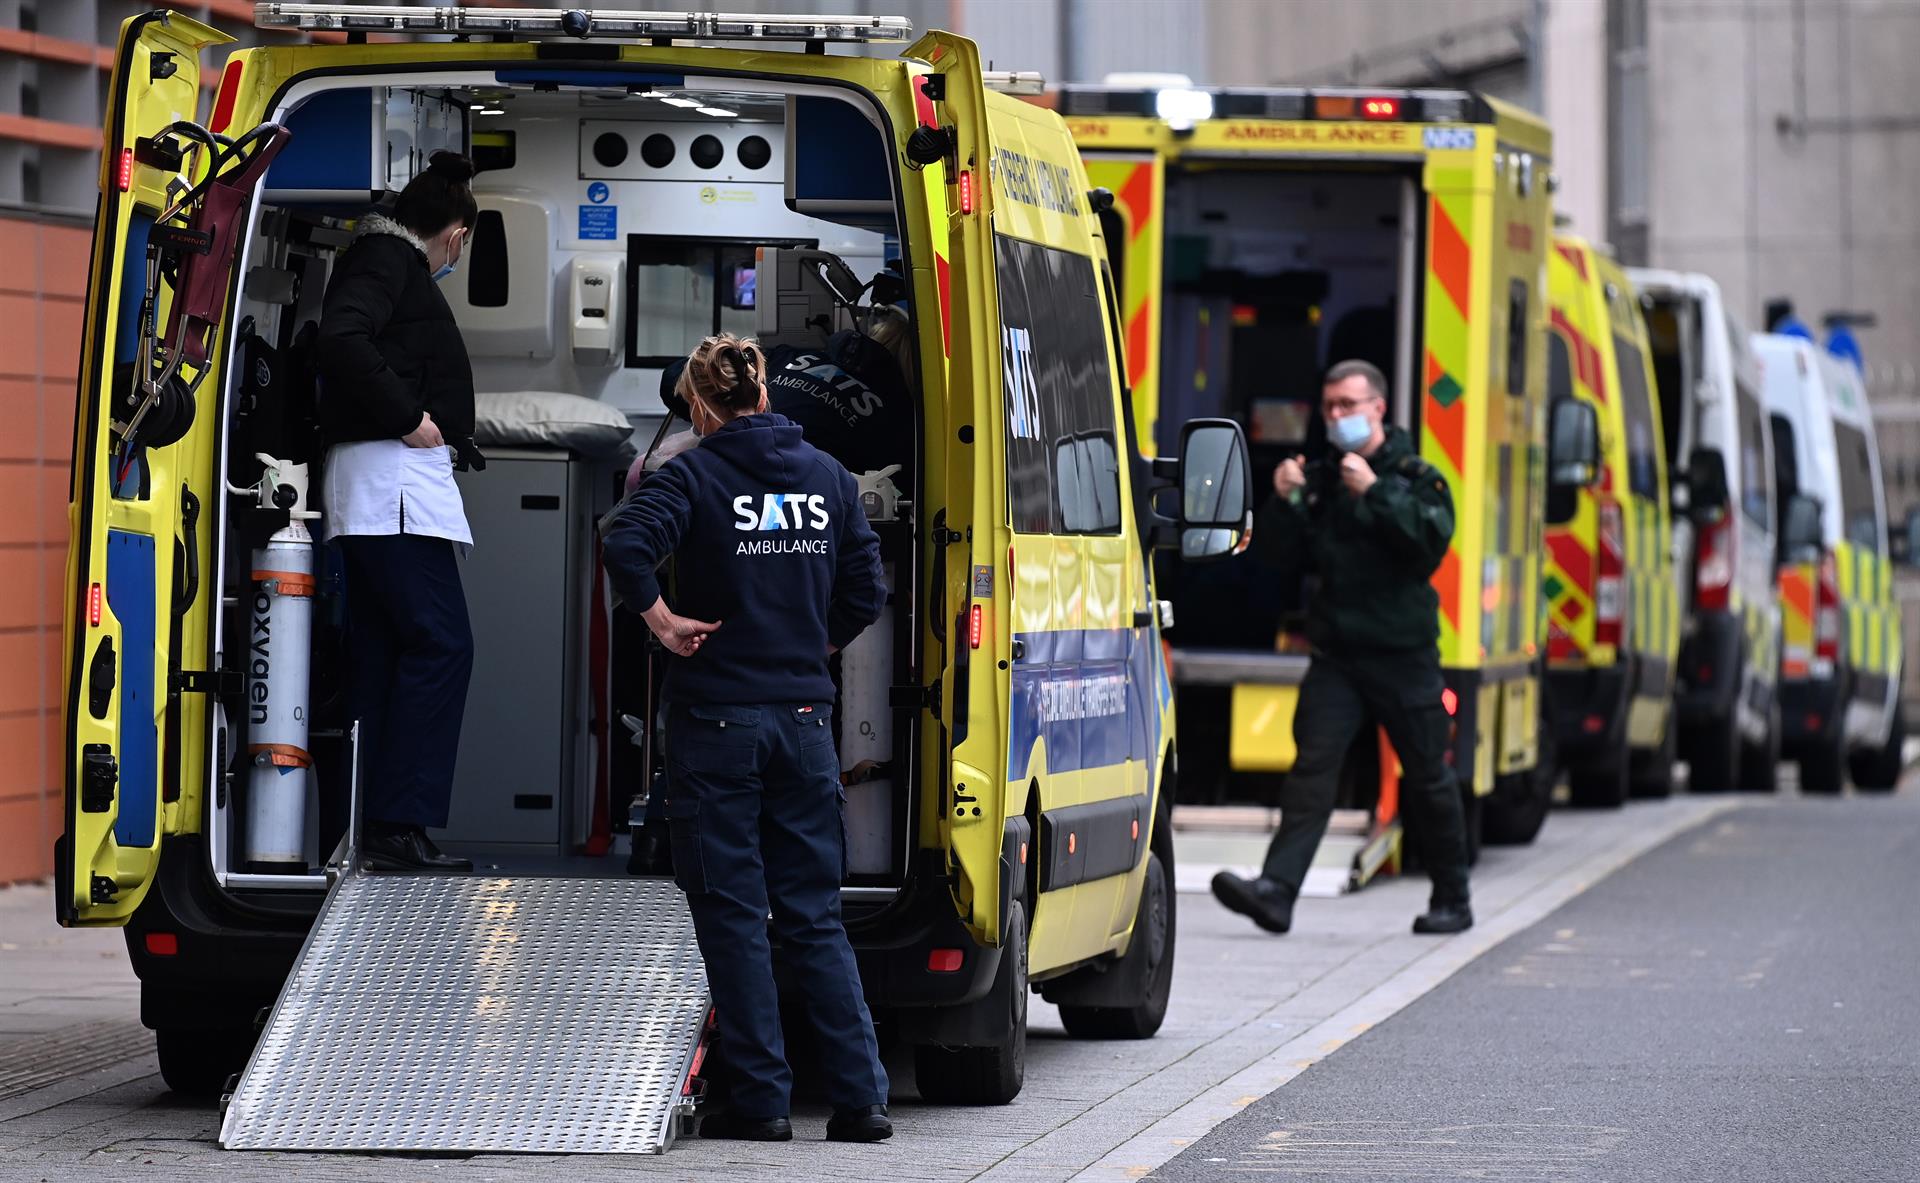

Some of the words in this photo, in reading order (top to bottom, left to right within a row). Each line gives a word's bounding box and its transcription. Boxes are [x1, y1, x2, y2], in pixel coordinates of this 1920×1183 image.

[1223, 126, 1407, 144] AMBULANCE
[1425, 128, 1474, 148] NHS
[769, 374, 858, 428] AMBULANCE
[785, 354, 884, 417] SATS
[1003, 324, 1040, 441] SATS
[733, 493, 829, 531] SATS
[736, 539, 829, 555] AMBULANCE
[250, 592, 271, 725] oxygen
